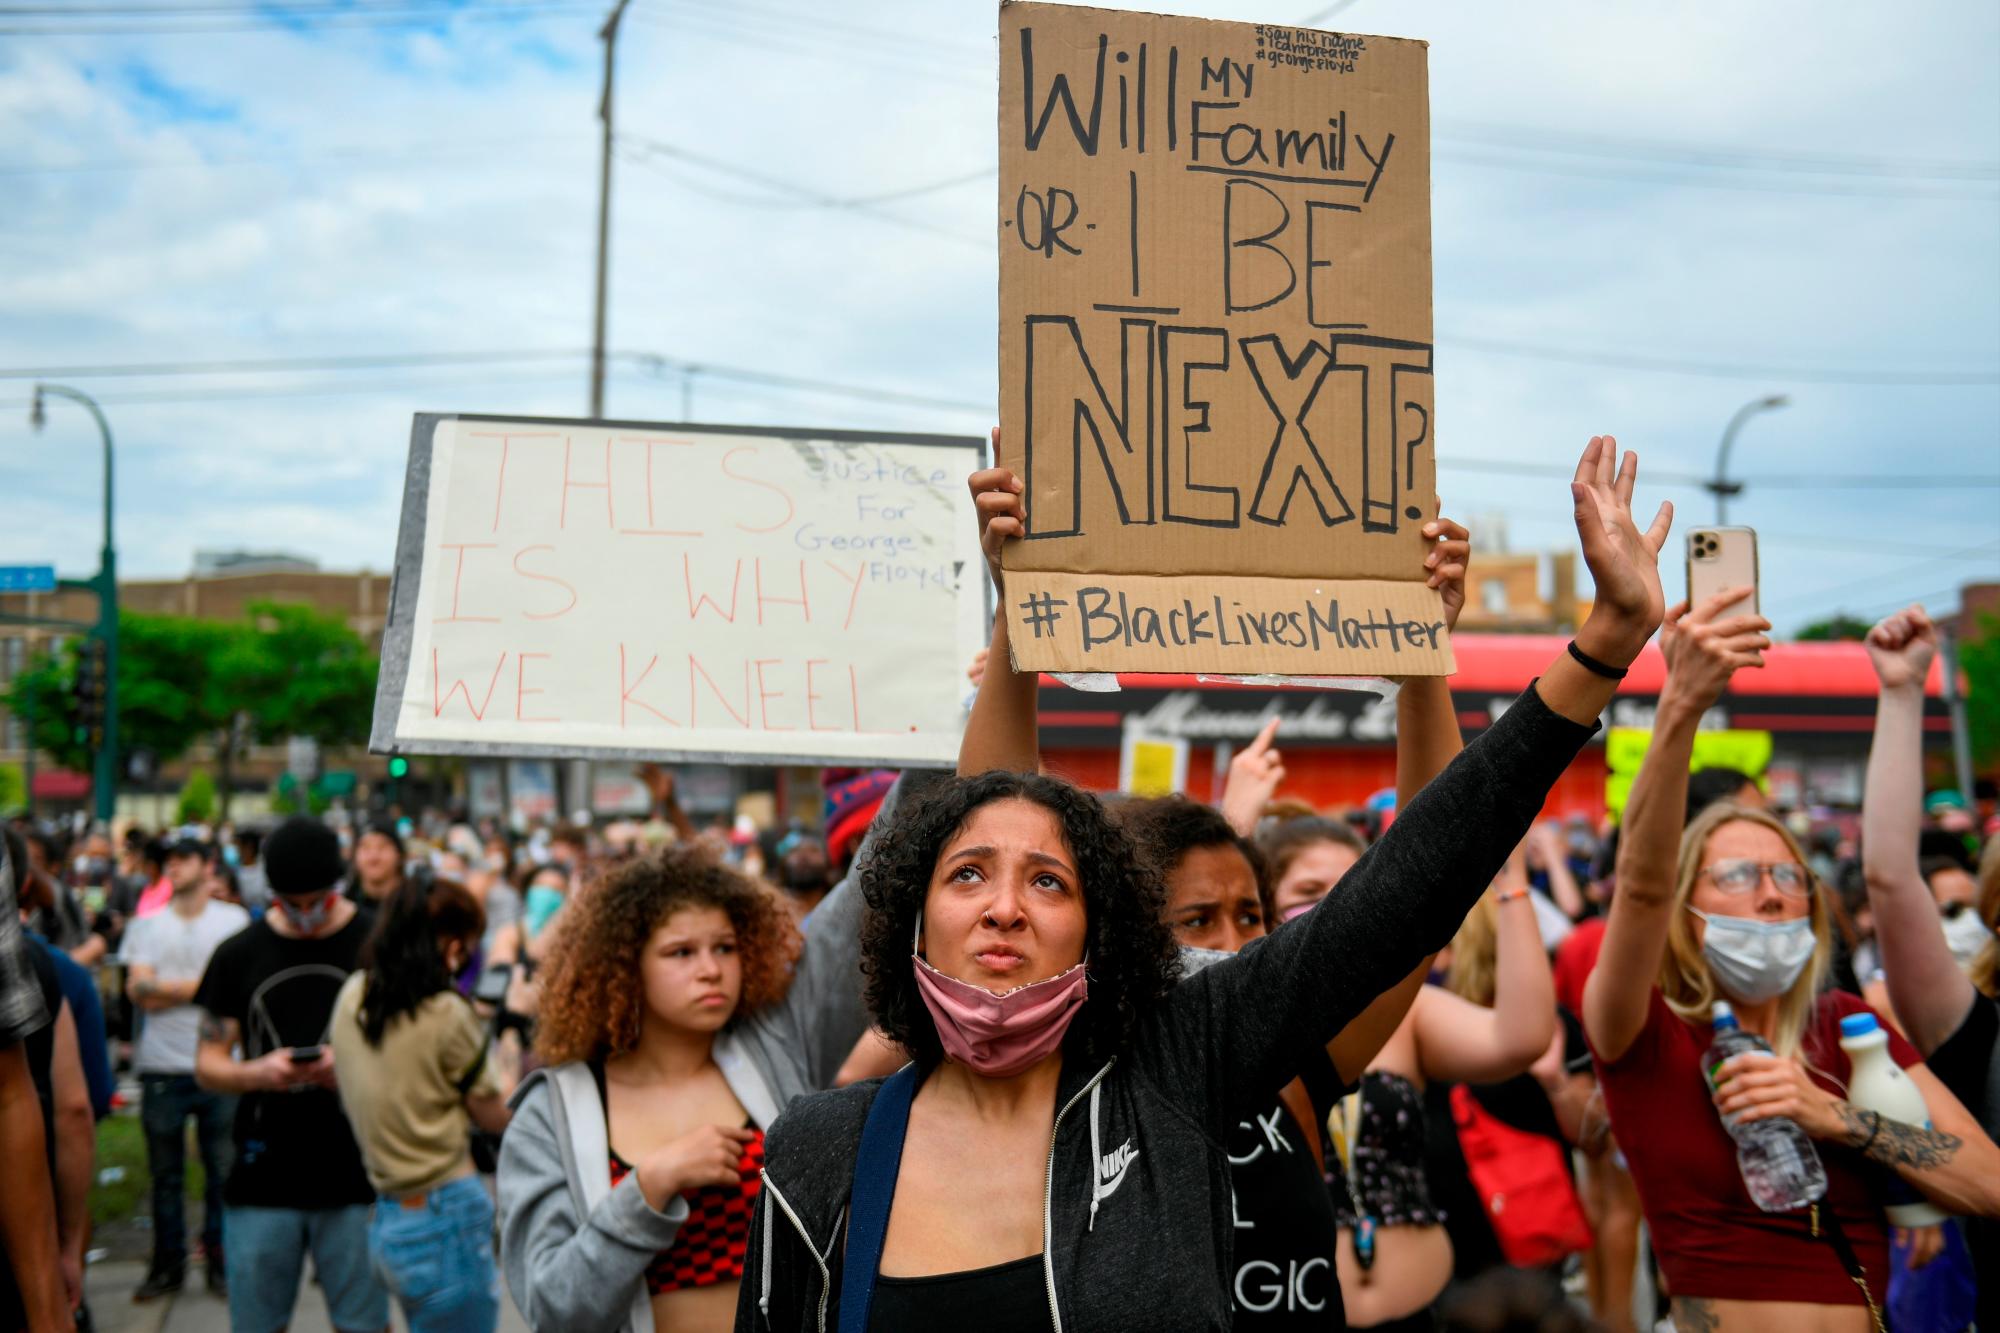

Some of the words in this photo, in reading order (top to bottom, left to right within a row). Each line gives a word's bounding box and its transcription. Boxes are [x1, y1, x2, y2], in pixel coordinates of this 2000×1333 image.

[1296, 30, 1316, 44] his
[1020, 27, 1177, 156] Will
[1190, 101, 1395, 203] Family
[1224, 179, 1368, 329] BE
[1024, 314, 1434, 539] NEXT?
[469, 431, 794, 536] THIS
[806, 446, 961, 490] Justice
[794, 522, 920, 557] George
[857, 494, 915, 521] For
[433, 543, 577, 622] IS
[684, 552, 866, 631] WHY
[1020, 586, 1448, 653] #BlackLivesMatter
[433, 647, 562, 722] WE
[1230, 1257, 1331, 1312] GIC
